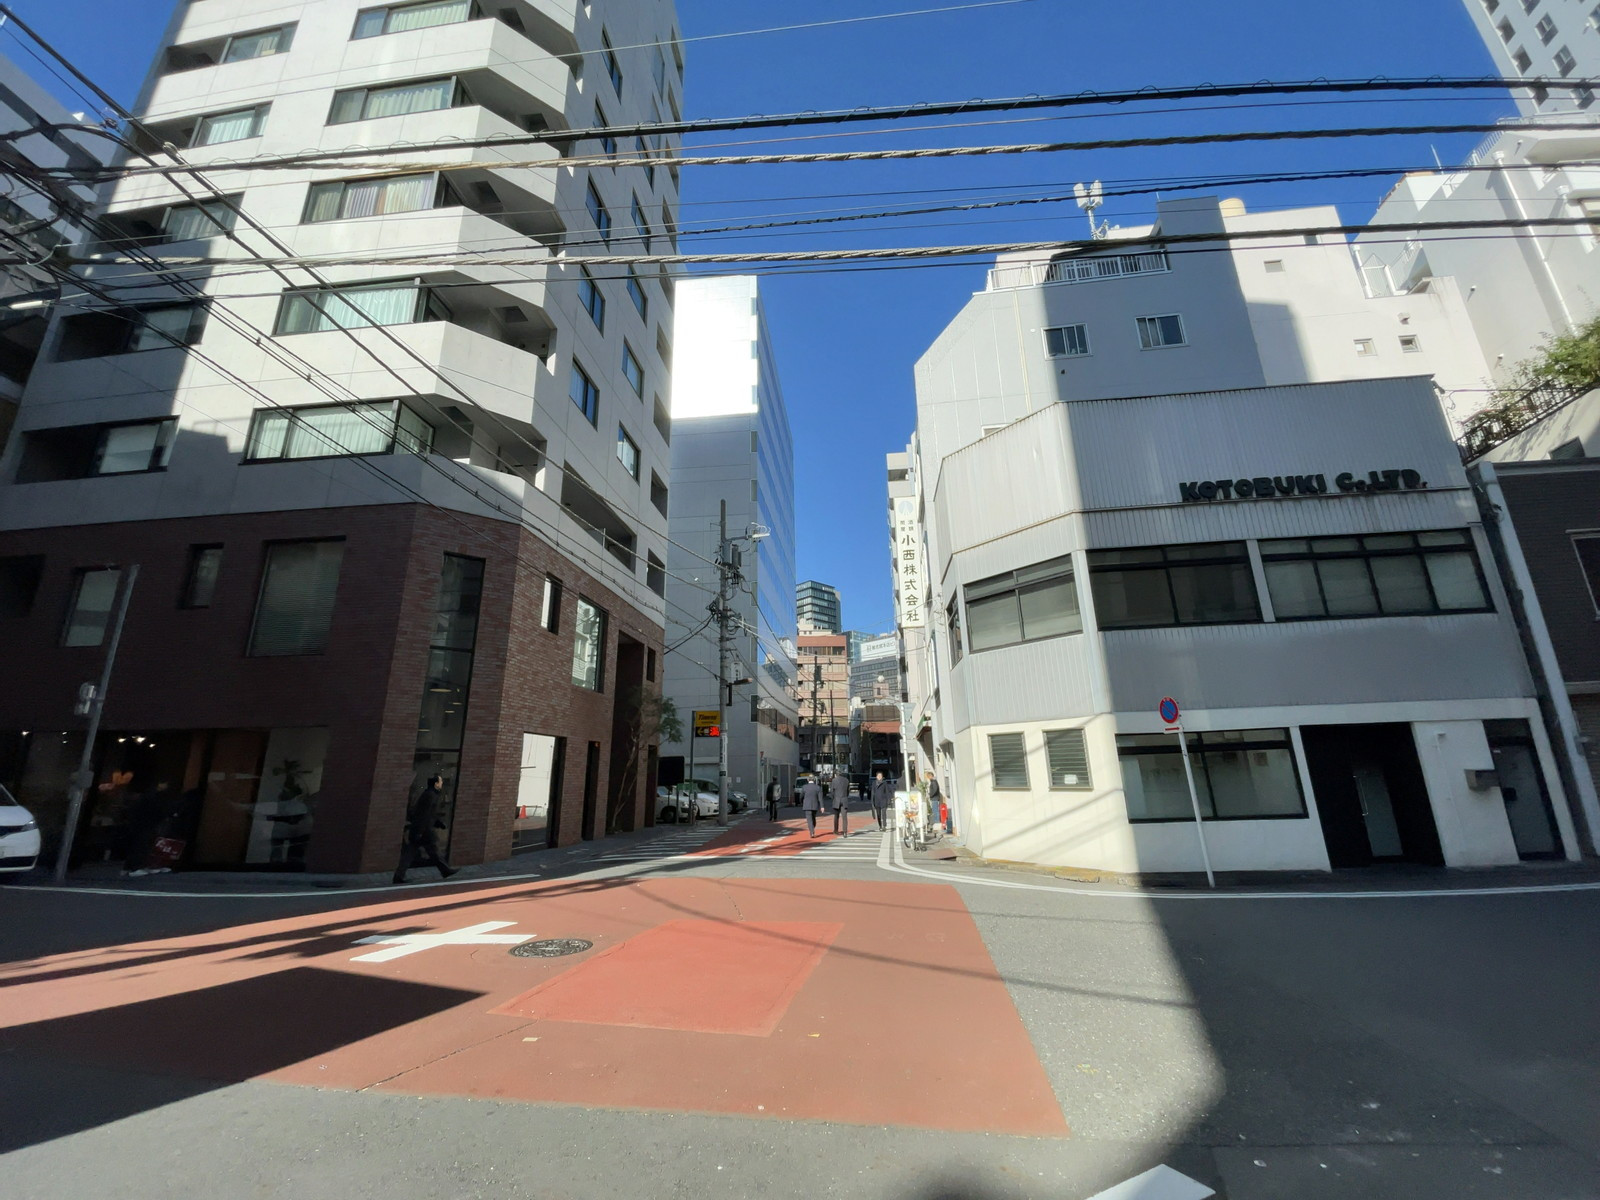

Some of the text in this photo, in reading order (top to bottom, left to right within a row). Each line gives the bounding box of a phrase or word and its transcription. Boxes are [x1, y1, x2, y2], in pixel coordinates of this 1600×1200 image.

[1179, 473, 1327, 502] KOTOBUKI
[901, 534, 920, 622] 小西株式会社
